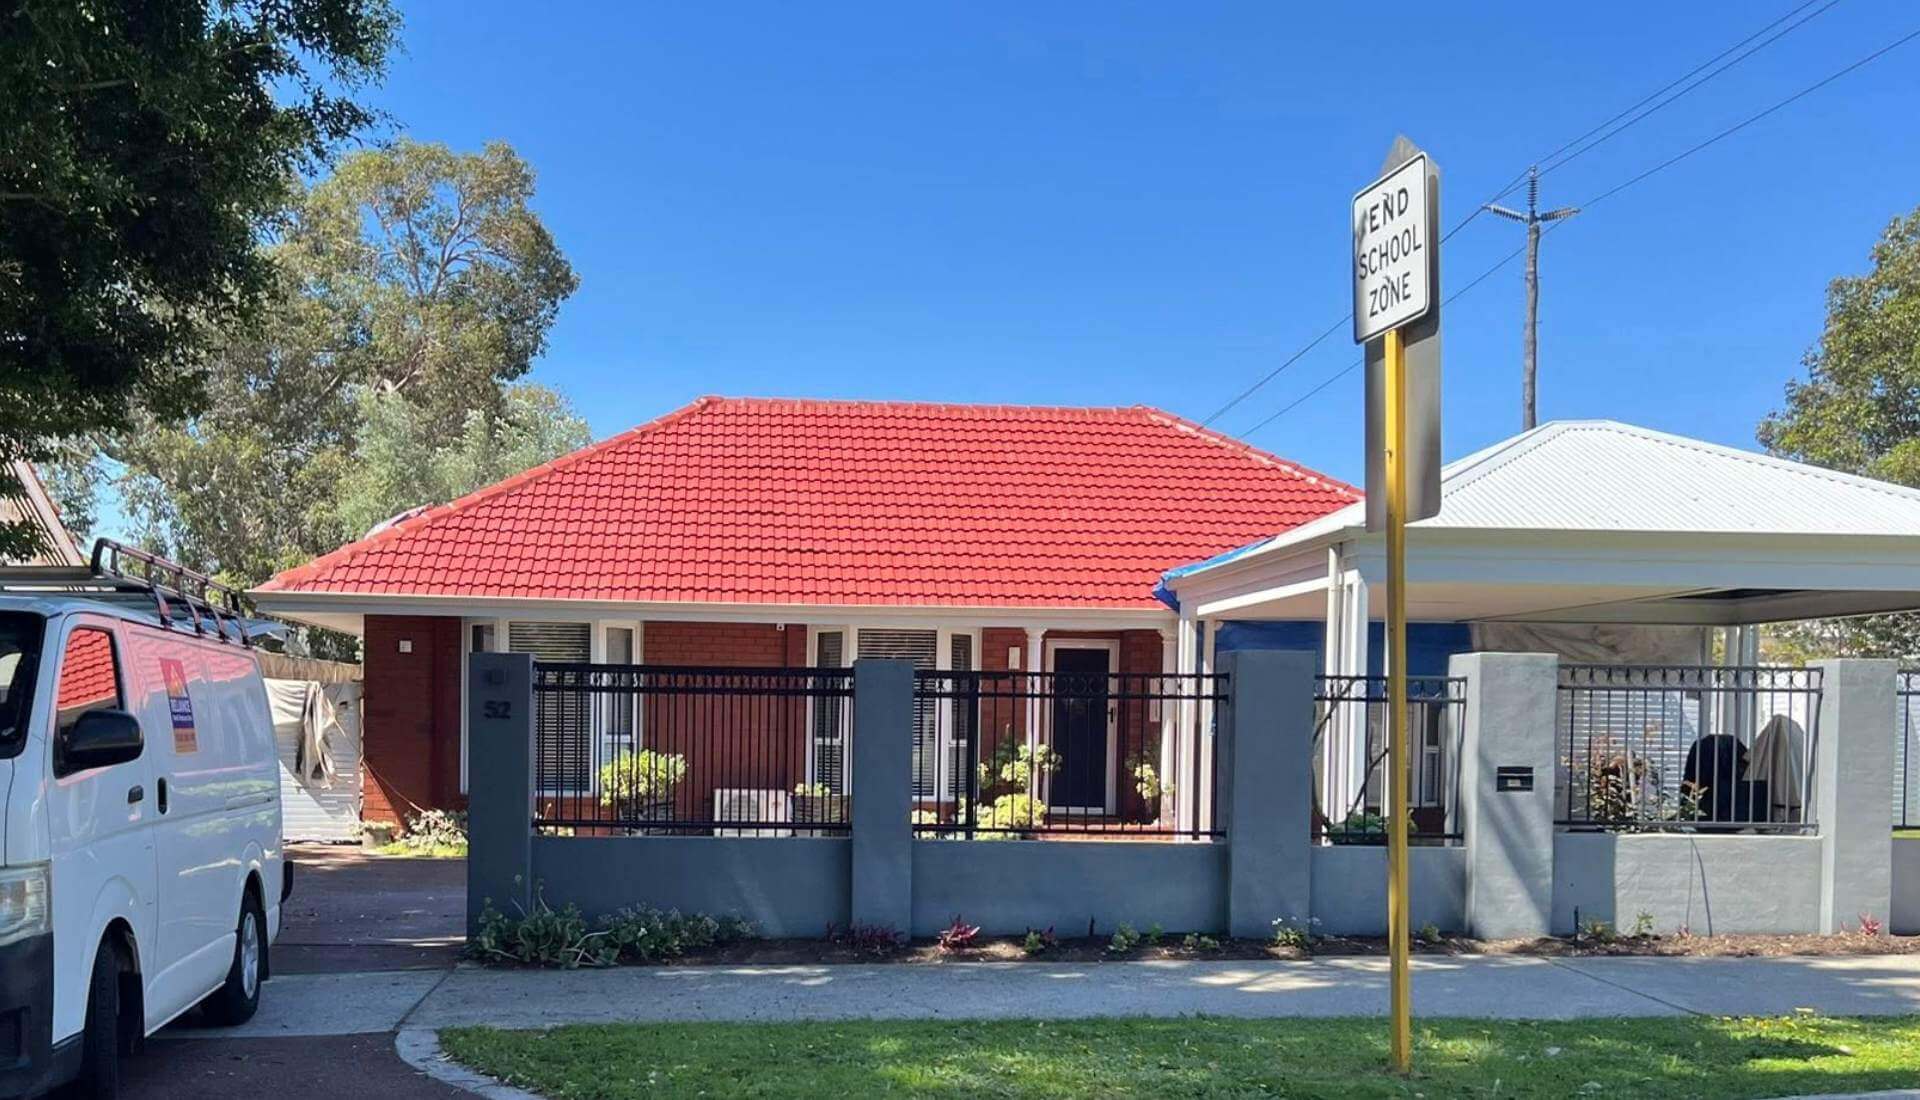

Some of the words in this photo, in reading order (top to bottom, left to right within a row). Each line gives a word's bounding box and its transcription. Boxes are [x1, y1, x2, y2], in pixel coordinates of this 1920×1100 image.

[1369, 187, 1409, 234] END
[1358, 223, 1422, 280] SCHOOL
[1369, 271, 1411, 318] ZONE
[484, 701, 511, 719] 52
